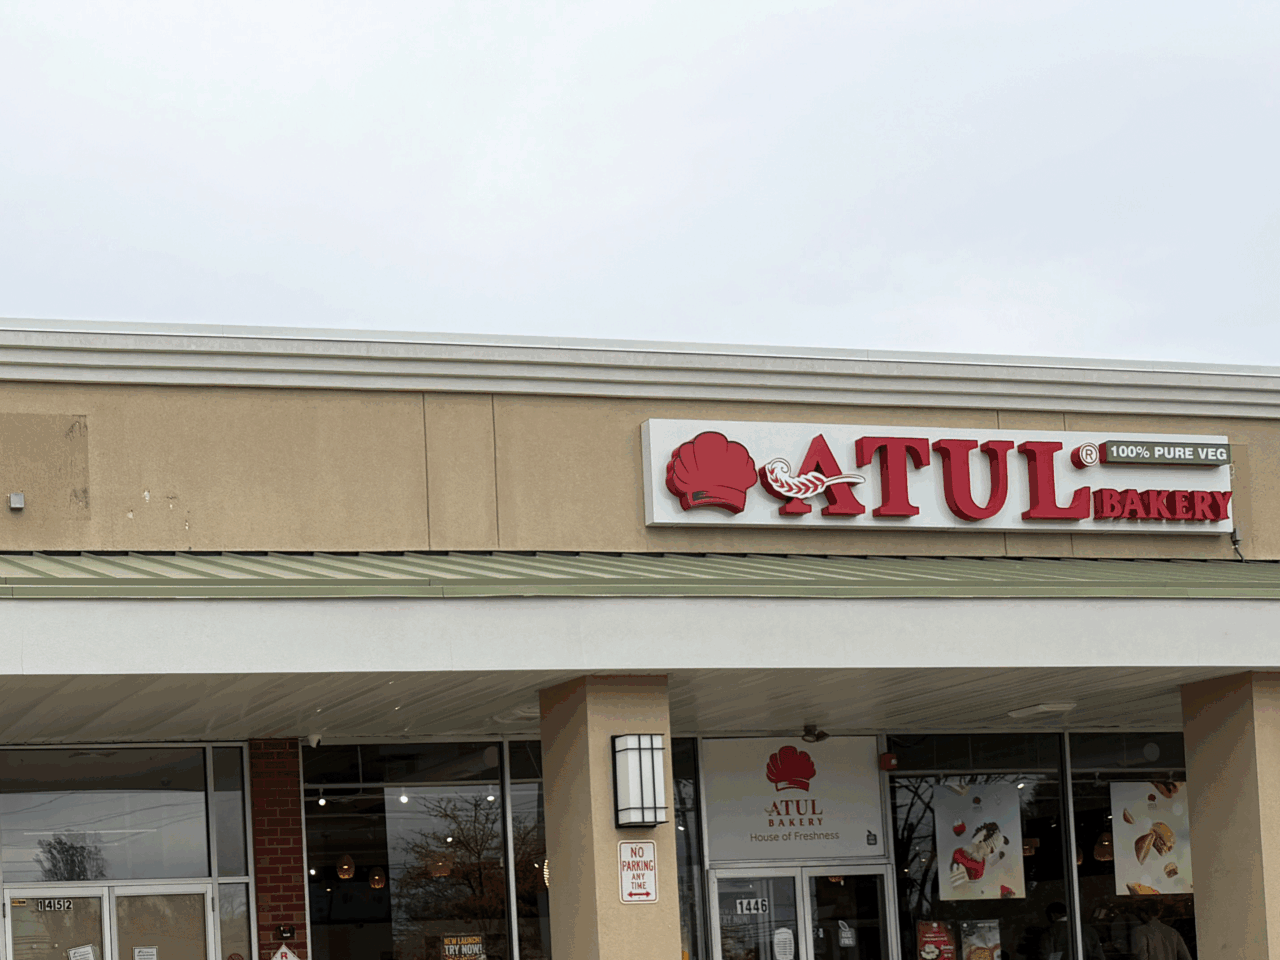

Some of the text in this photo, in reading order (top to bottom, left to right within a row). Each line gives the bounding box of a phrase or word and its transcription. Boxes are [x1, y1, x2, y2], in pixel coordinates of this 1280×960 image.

[1111, 445, 1227, 460] 100% PURE VEG
[762, 434, 1091, 521] ATUL
[1093, 488, 1233, 520] BAKERY
[764, 799, 823, 816] ATUL
[768, 818, 823, 827] BAKERY
[750, 831, 839, 842] House of Freshness
[630, 847, 644, 858] NO
[622, 860, 653, 871] PARKING
[38, 900, 73, 910] 1452
[738, 899, 767, 913] 1446
[444, 944, 482, 954] TRY NOW!
